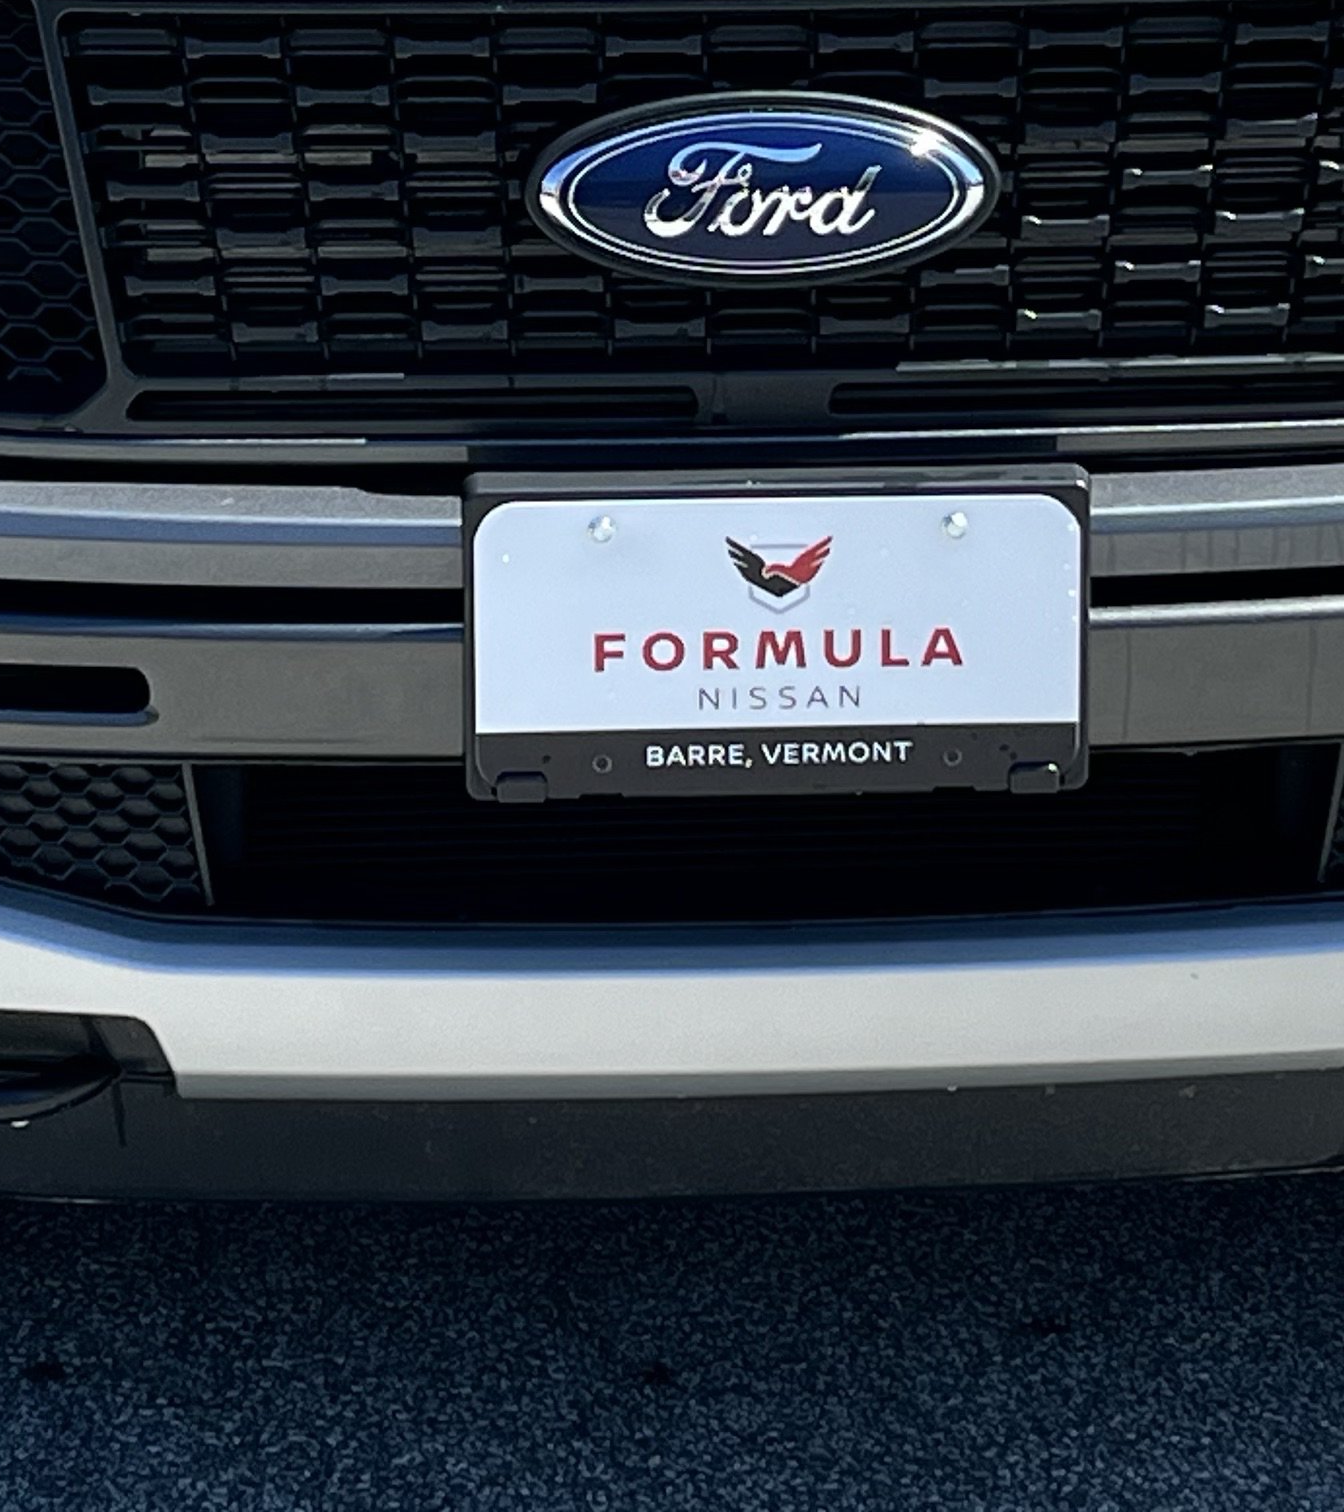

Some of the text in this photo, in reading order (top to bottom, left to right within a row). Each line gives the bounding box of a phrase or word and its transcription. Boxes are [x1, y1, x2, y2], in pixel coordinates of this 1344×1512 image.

[644, 141, 883, 238] Ford
[592, 627, 964, 672] FORMULA
[698, 685, 862, 711] NISSAN
[645, 740, 913, 769] BARRE, VERMONT
